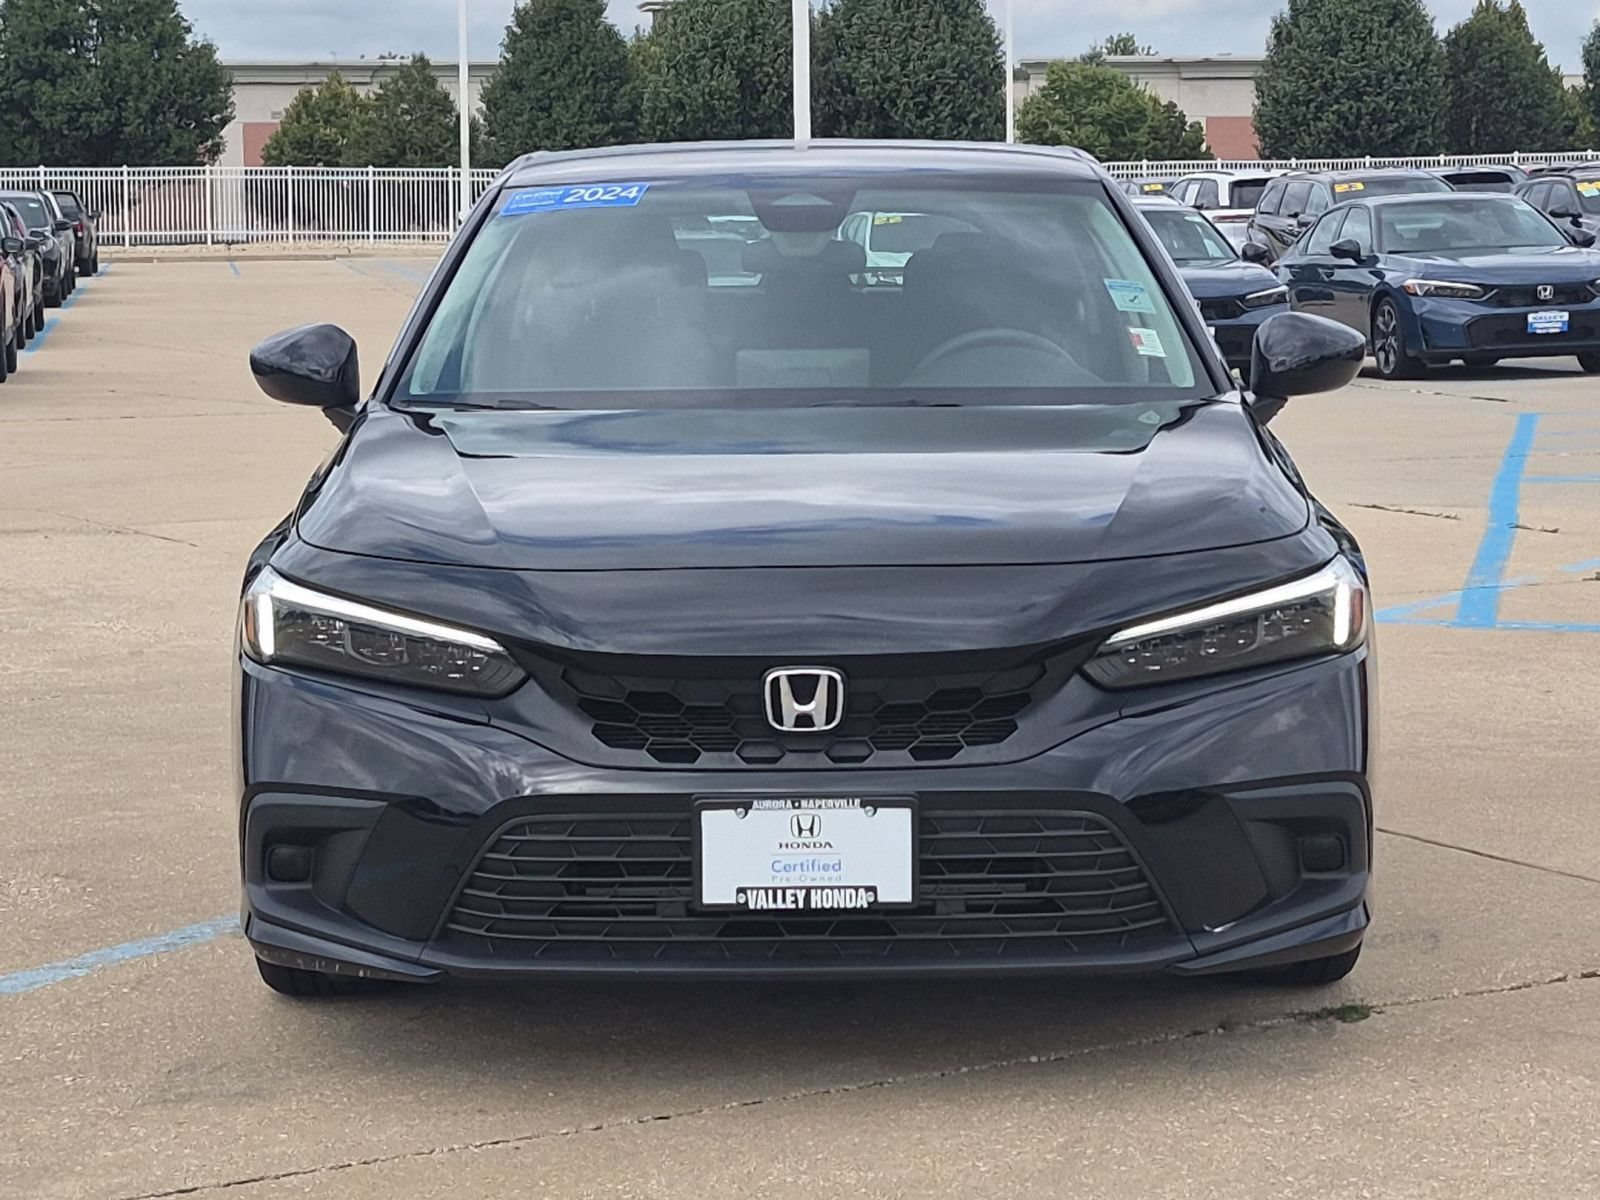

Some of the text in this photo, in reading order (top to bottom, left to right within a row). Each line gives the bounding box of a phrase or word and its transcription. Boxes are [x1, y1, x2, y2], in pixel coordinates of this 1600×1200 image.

[563, 186, 640, 203] 2024
[752, 798, 861, 809] AURORA NAPERVILLE
[778, 841, 834, 849] HONDA
[771, 859, 842, 873] Certified
[771, 874, 842, 883] Pre-Owned
[746, 888, 868, 909] VALLEY HONDA
